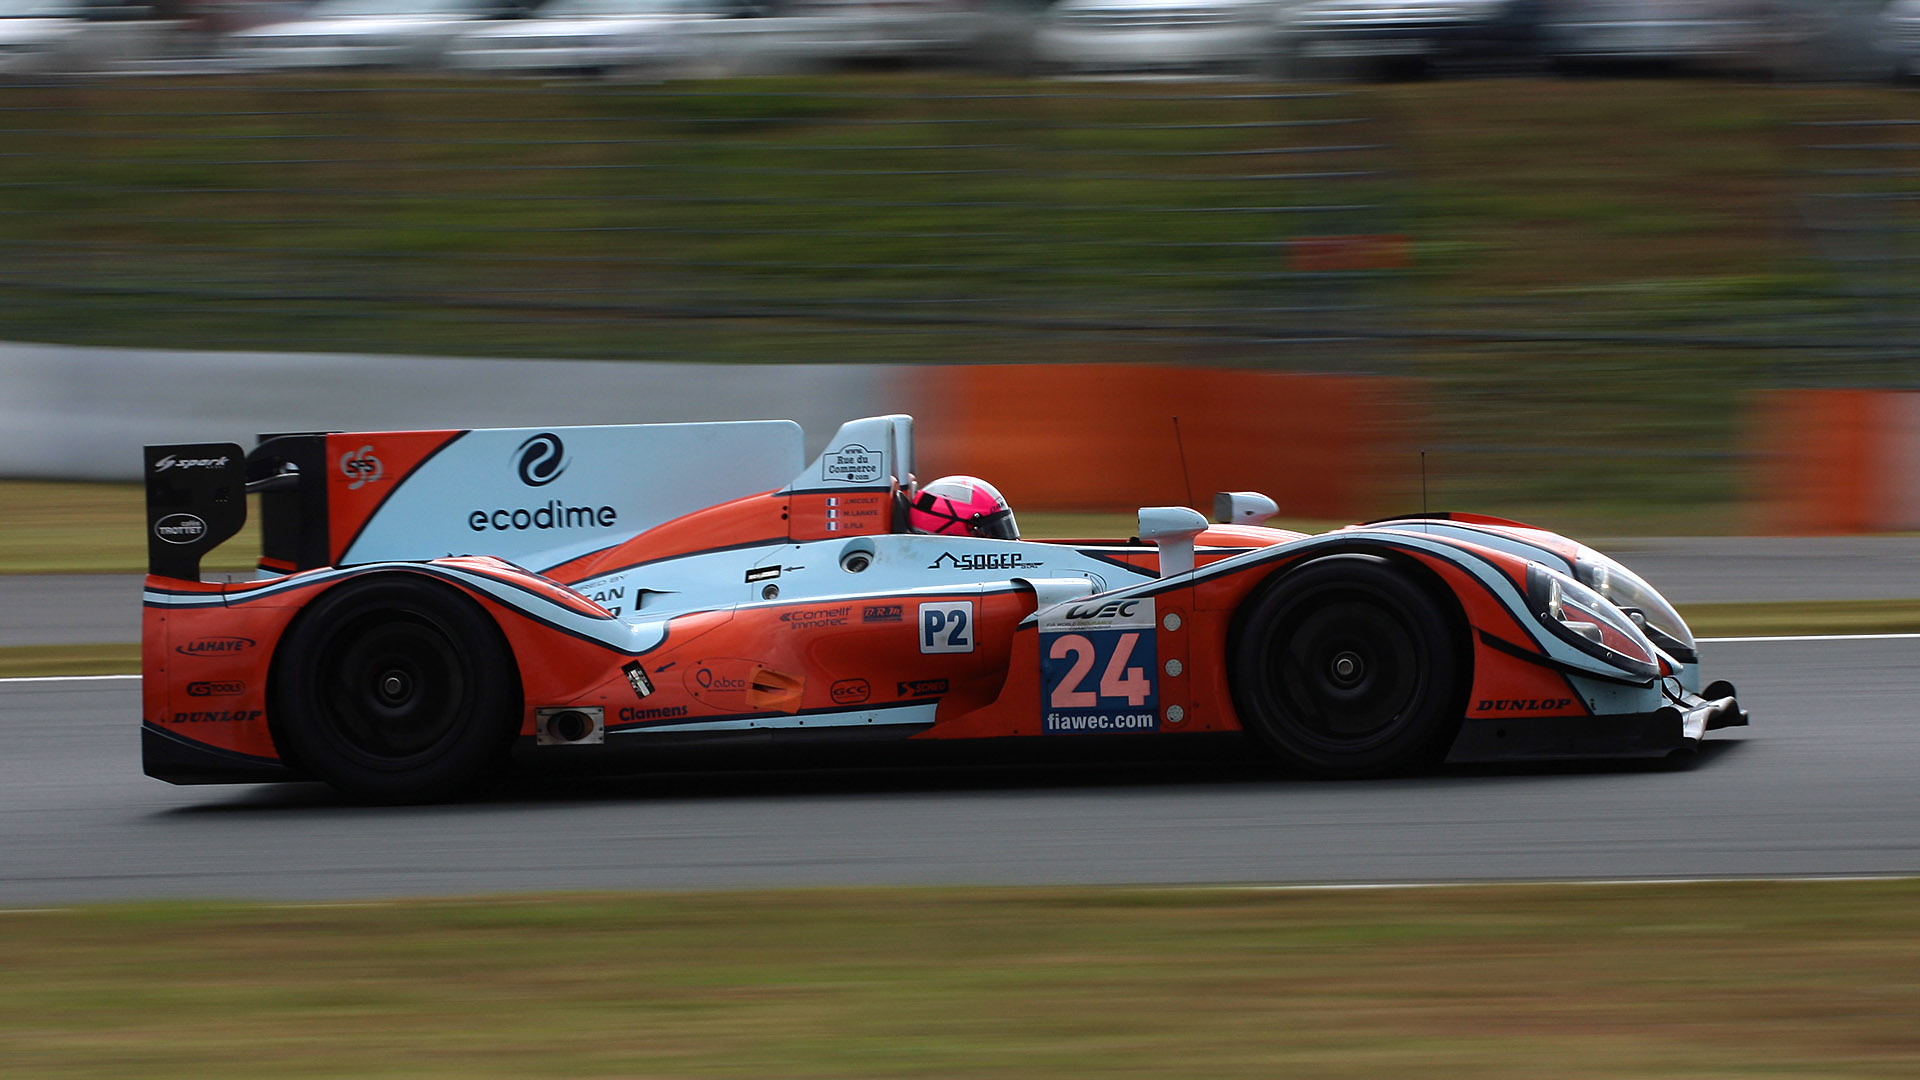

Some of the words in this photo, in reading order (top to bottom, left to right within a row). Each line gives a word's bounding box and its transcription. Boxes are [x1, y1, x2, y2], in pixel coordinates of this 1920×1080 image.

[175, 456, 229, 469] spark
[837, 456, 854, 464] Rue
[856, 455, 868, 464] du
[828, 465, 876, 473] Commerce
[469, 500, 617, 531] ecodime
[159, 526, 202, 535] TROTTET
[961, 553, 1022, 570] SOGEP
[1065, 600, 1140, 619] WEC
[924, 609, 968, 647] P2
[187, 641, 243, 652] LAHAYE
[1050, 633, 1150, 708] 24
[833, 685, 868, 696] GCC
[1476, 699, 1572, 711] DUNLOP
[172, 710, 263, 723] DUNLOP
[618, 705, 688, 721] Clamens
[1047, 713, 1153, 729] fiawec.com
